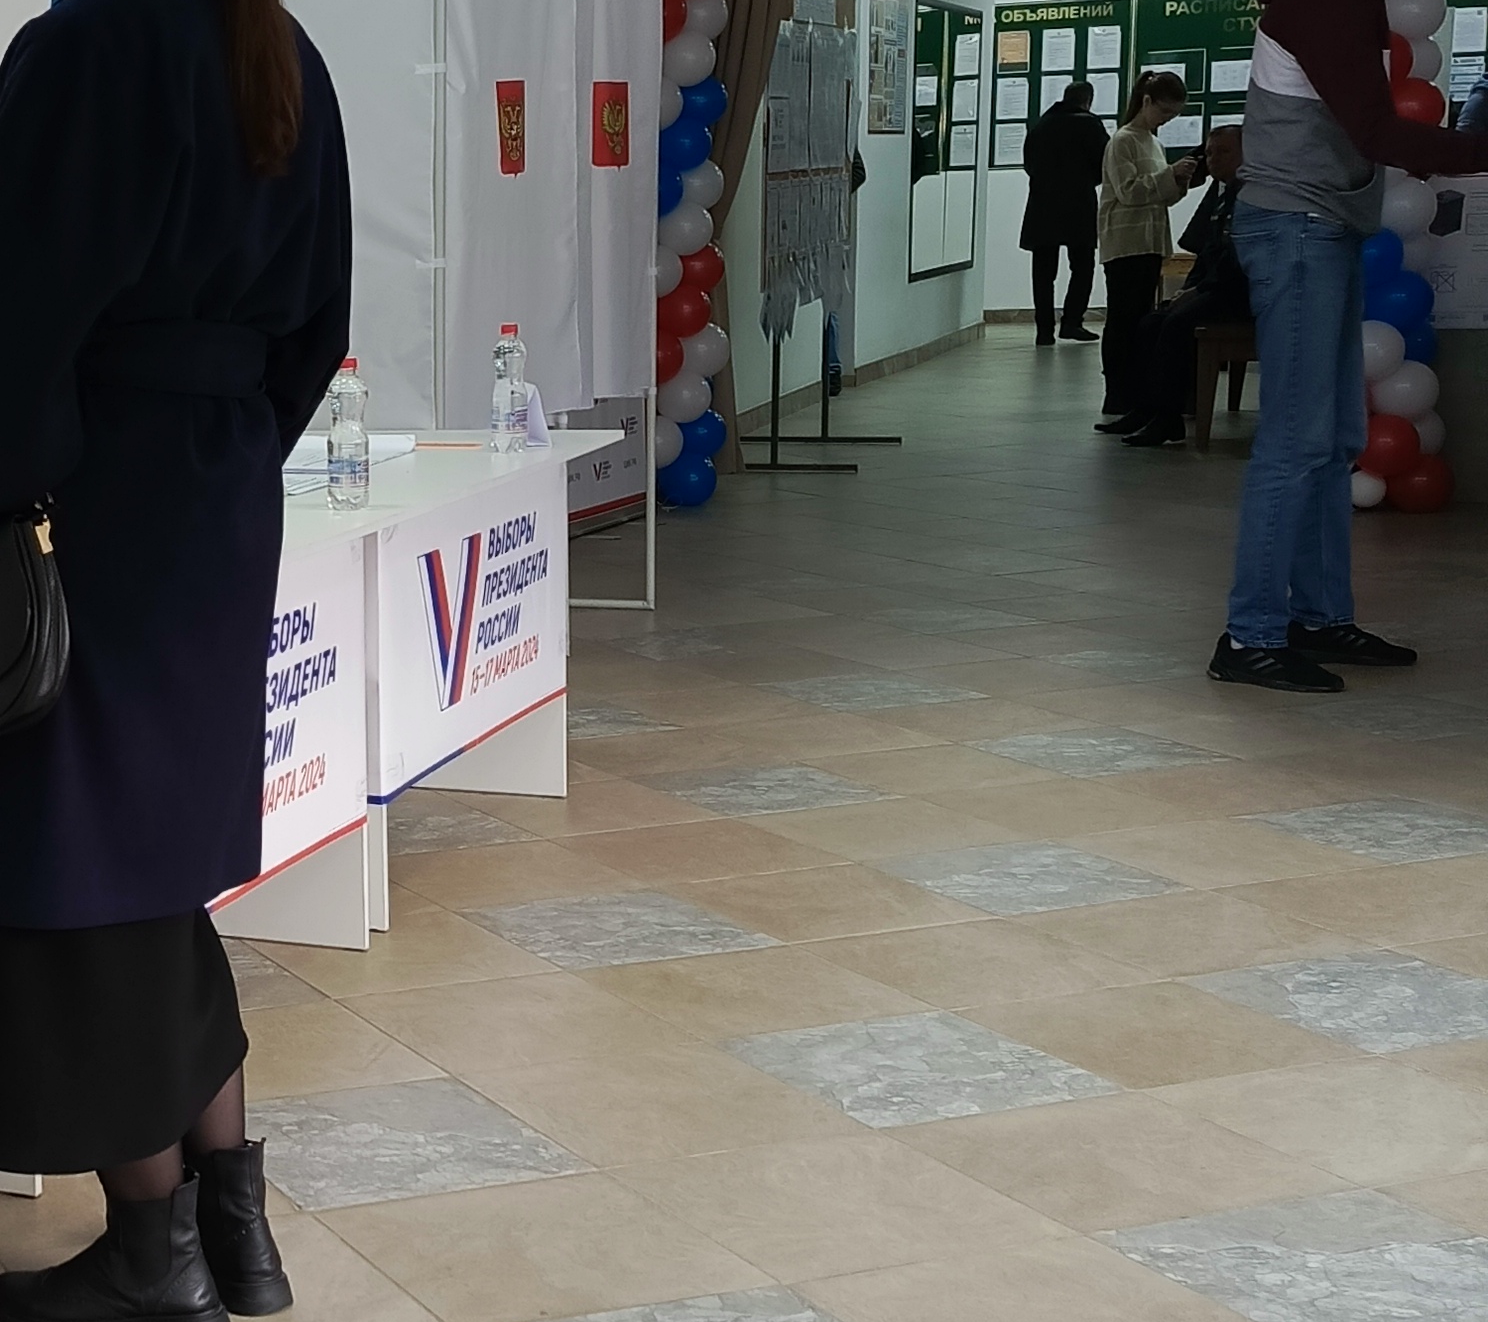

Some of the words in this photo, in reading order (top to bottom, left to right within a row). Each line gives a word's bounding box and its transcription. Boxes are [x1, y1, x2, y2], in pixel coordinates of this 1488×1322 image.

[1001, 1, 1114, 23] ОБЪЯВЛЕНИЙ
[1223, 16, 1261, 32] СТУ
[487, 511, 537, 561] ВЫБОРЫ
[481, 547, 549, 608] ПРЕЗИДЕНТА
[268, 602, 316, 659] БОРЫ
[475, 603, 521, 654] РОССИИ
[266, 646, 337, 713] ЗИДЕНТА
[492, 644, 520, 681] МАРТА
[520, 633, 539, 667] 2024
[298, 753, 326, 798] 2024
